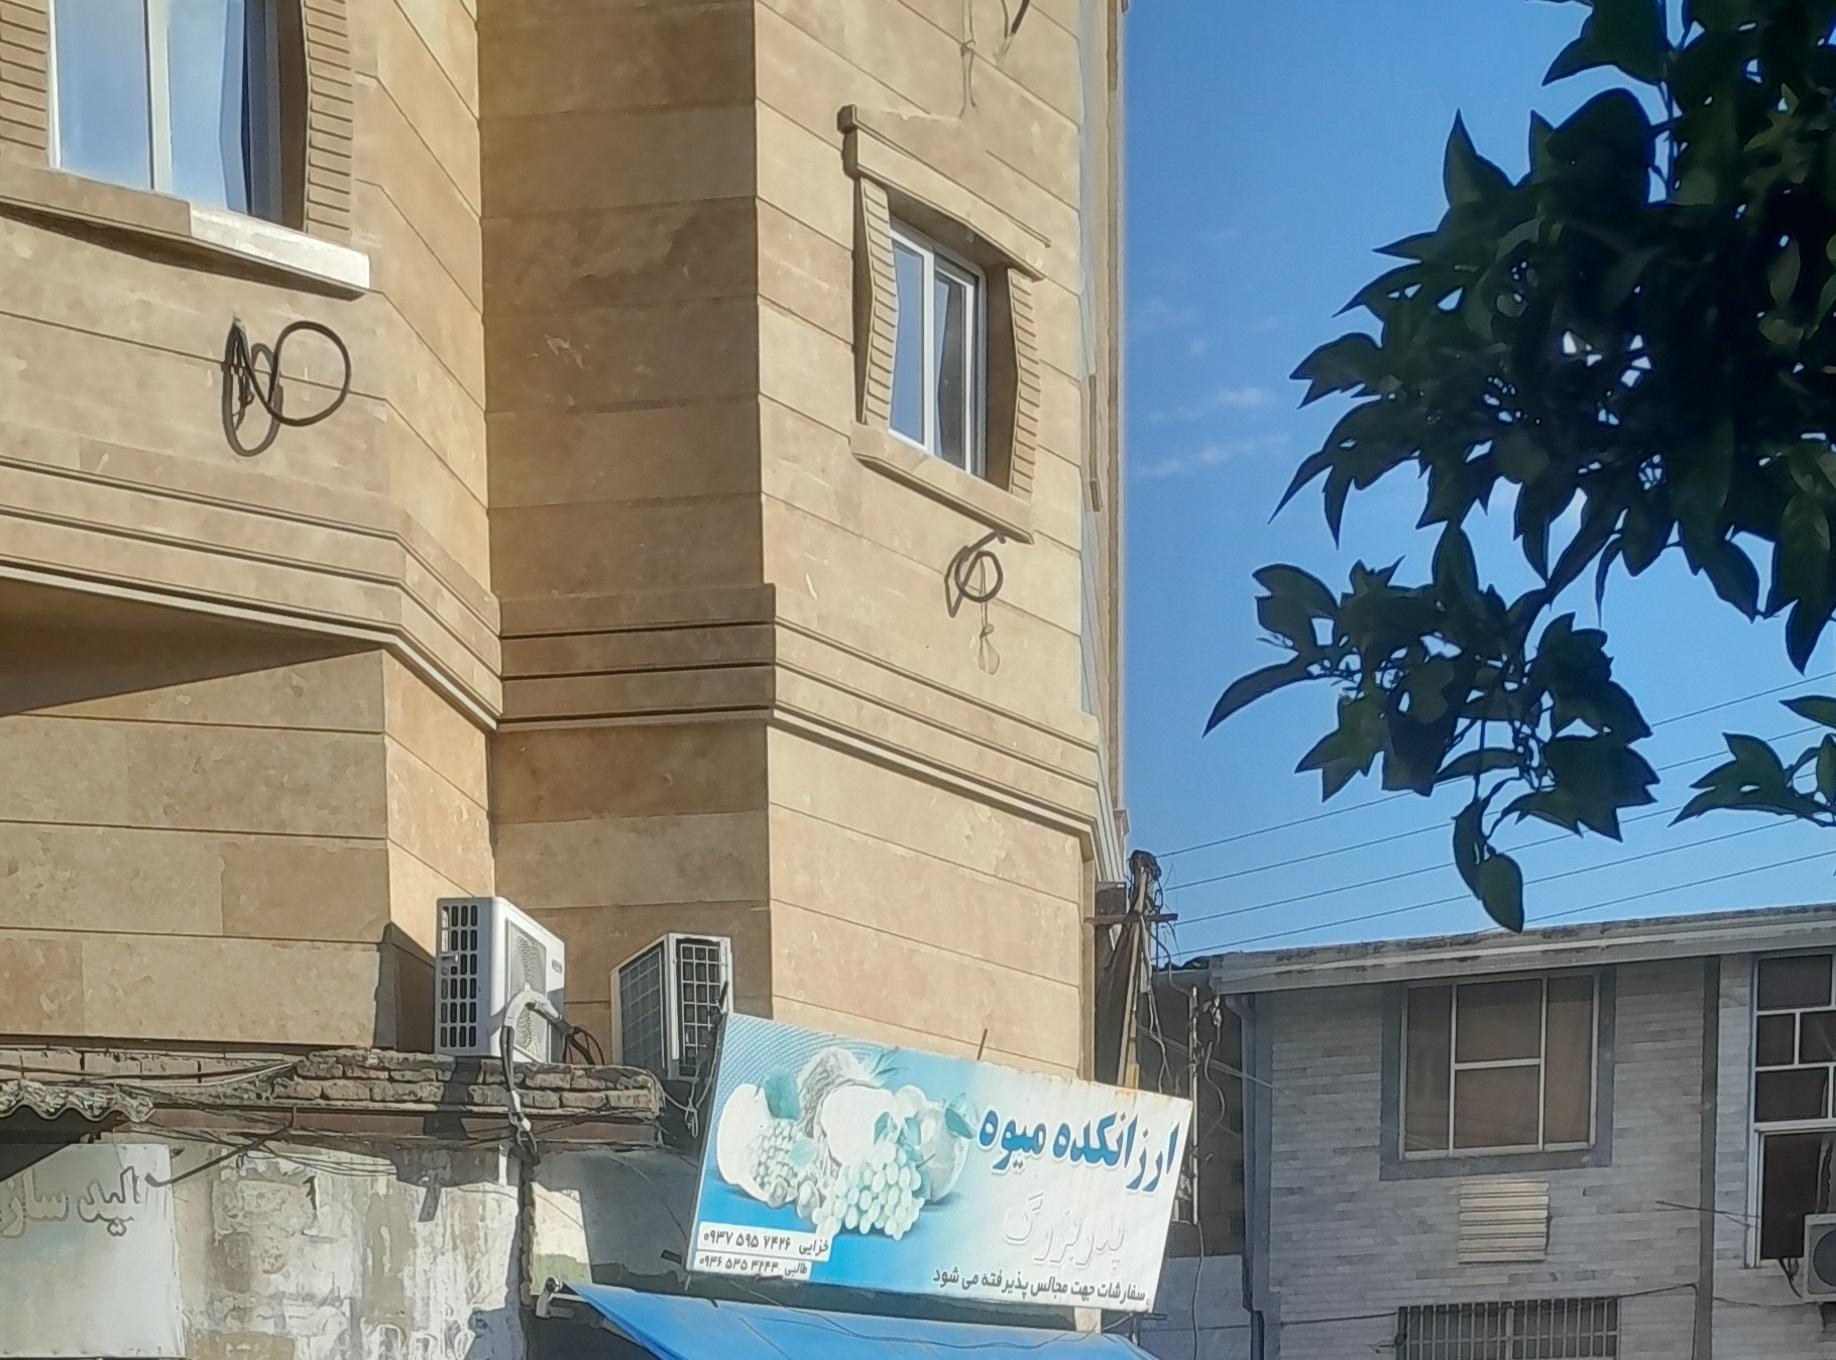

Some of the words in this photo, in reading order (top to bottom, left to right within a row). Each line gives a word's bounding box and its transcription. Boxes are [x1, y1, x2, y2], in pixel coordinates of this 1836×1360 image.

[979, 1109, 1047, 1170] میوه
[1053, 1111, 1180, 1193] ارزانکده
[703, 1229, 734, 1246] ۰۹۳۷
[735, 1232, 760, 1249] ۵۹۵
[699, 1255, 722, 1269] ۰۹۳۶
[725, 1257, 748, 1271] ۵۳۵
[784, 1262, 808, 1277] طالبی
[933, 1266, 959, 1288] شود
[961, 1274, 978, 1291] می
[982, 1269, 1029, 1299] پذیرفته
[1030, 1276, 1068, 1299] مجالس
[1071, 1281, 1096, 1302] جهت
[1099, 1281, 1146, 1305] سفارشات
